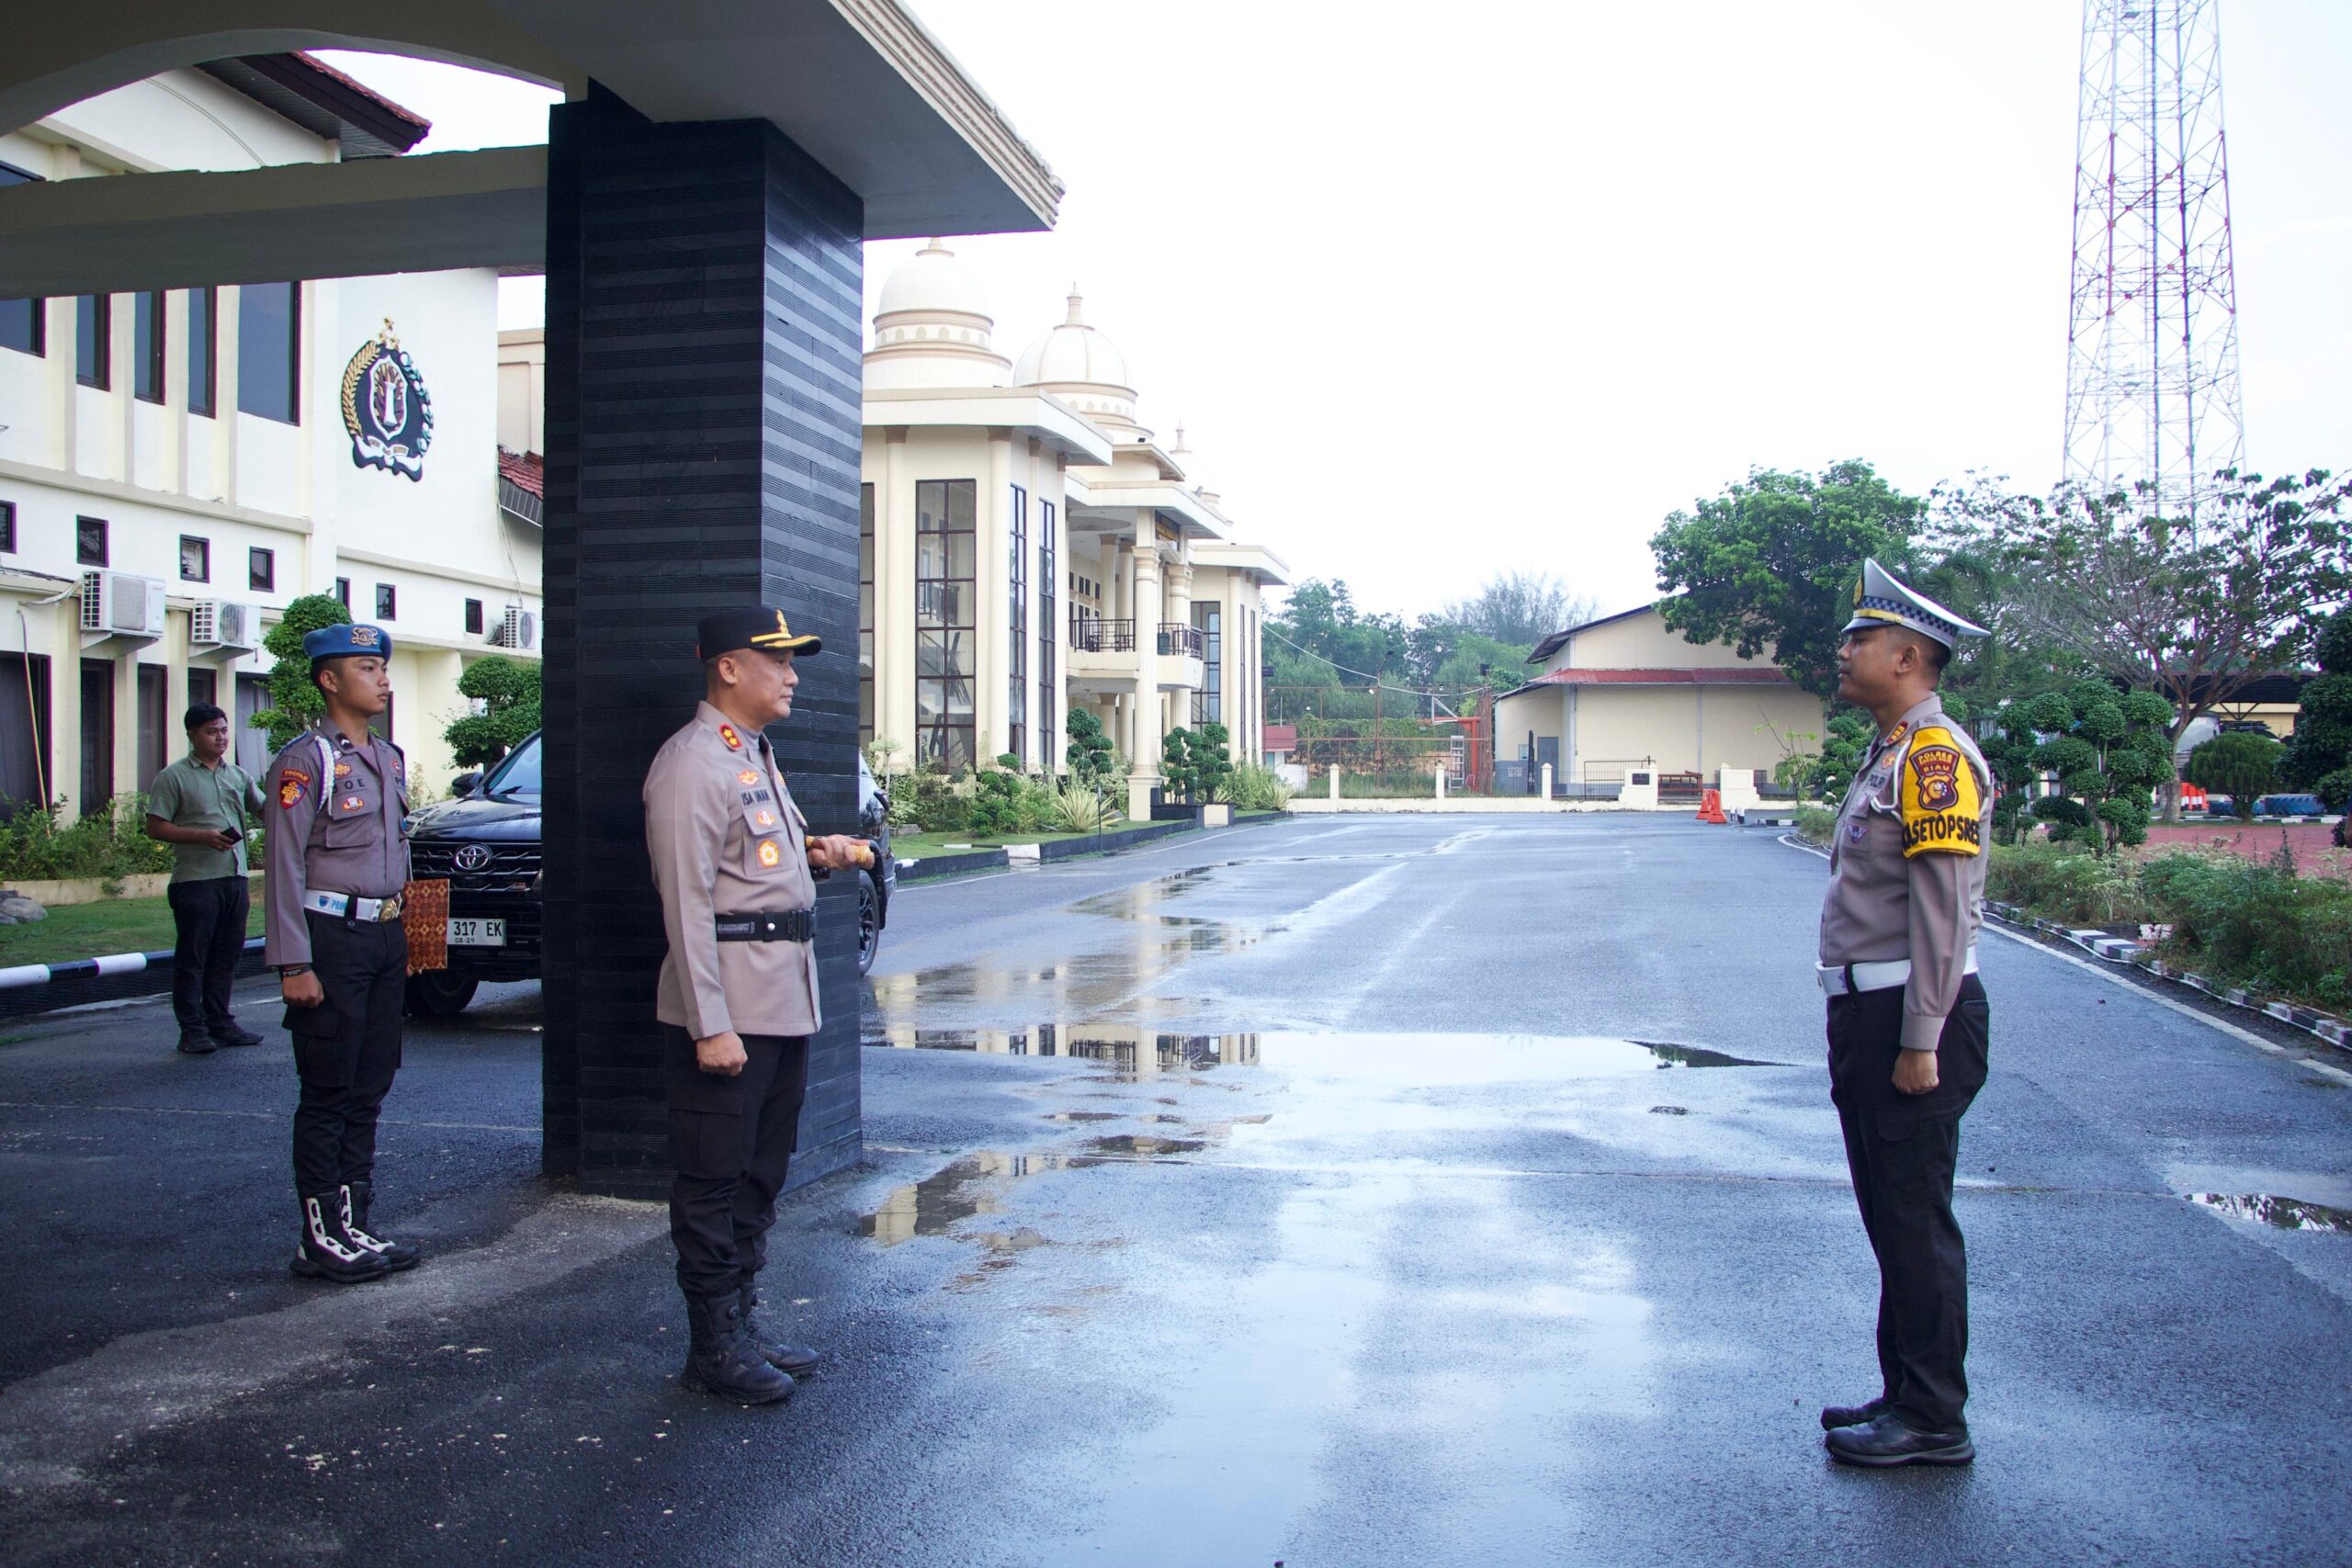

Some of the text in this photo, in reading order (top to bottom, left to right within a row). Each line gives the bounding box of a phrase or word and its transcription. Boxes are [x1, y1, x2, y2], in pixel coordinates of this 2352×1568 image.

[1923, 764, 1950, 773] RIAU
[454, 921, 503, 936] 317 EK
